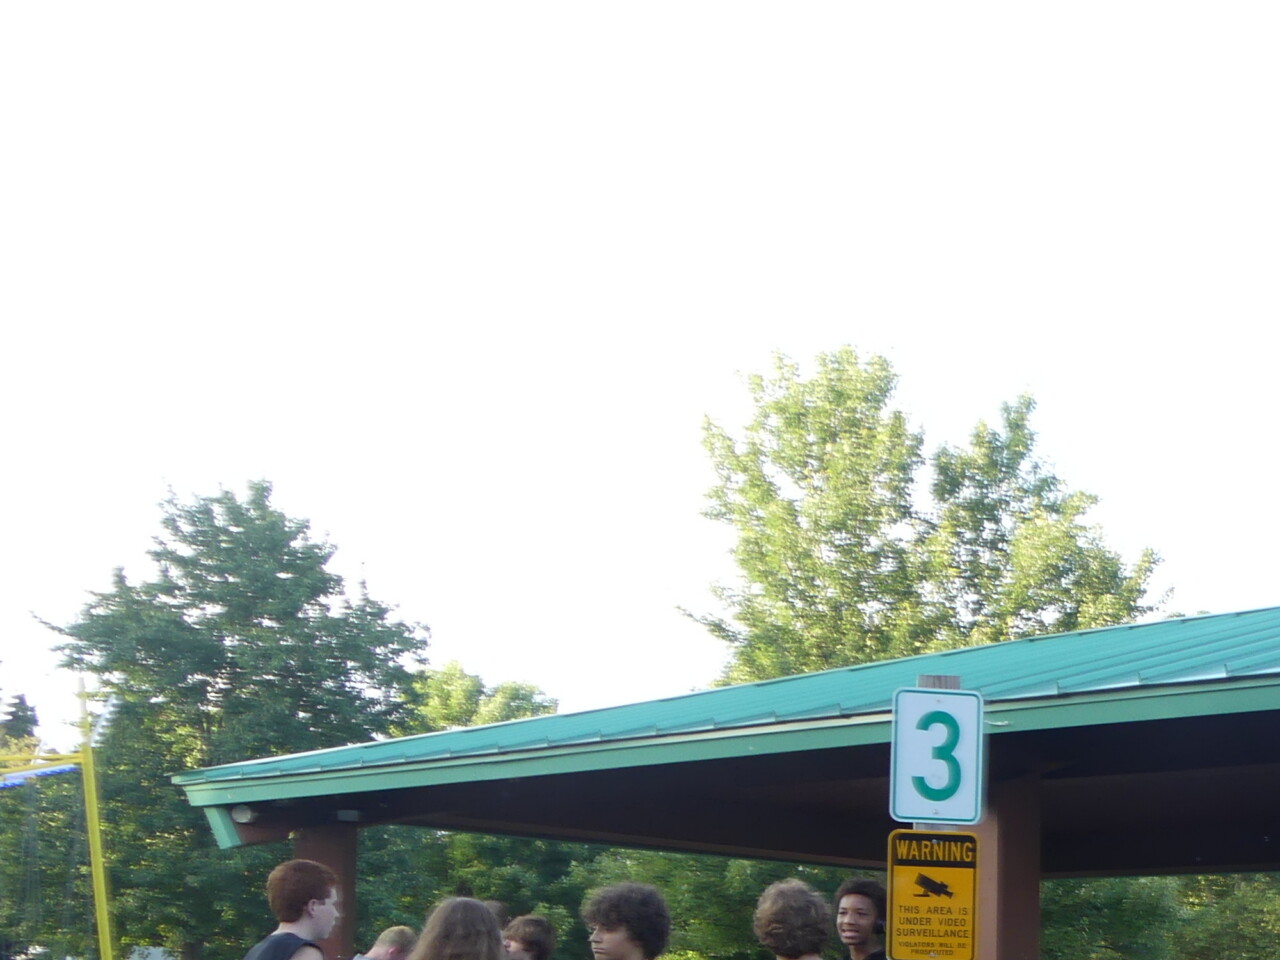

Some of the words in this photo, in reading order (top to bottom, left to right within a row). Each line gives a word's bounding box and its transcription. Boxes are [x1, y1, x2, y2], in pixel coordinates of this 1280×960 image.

[911, 710, 961, 802] 3
[896, 839, 973, 862] WARNING
[899, 905, 920, 914] THIS
[926, 906, 952, 915] AREA
[958, 907, 968, 915] IS
[899, 917, 931, 926] UNDER
[938, 918, 966, 927] VIDEO
[896, 928, 969, 938] SURVEILLANCE
[910, 948, 954, 956] PROSECUTED
